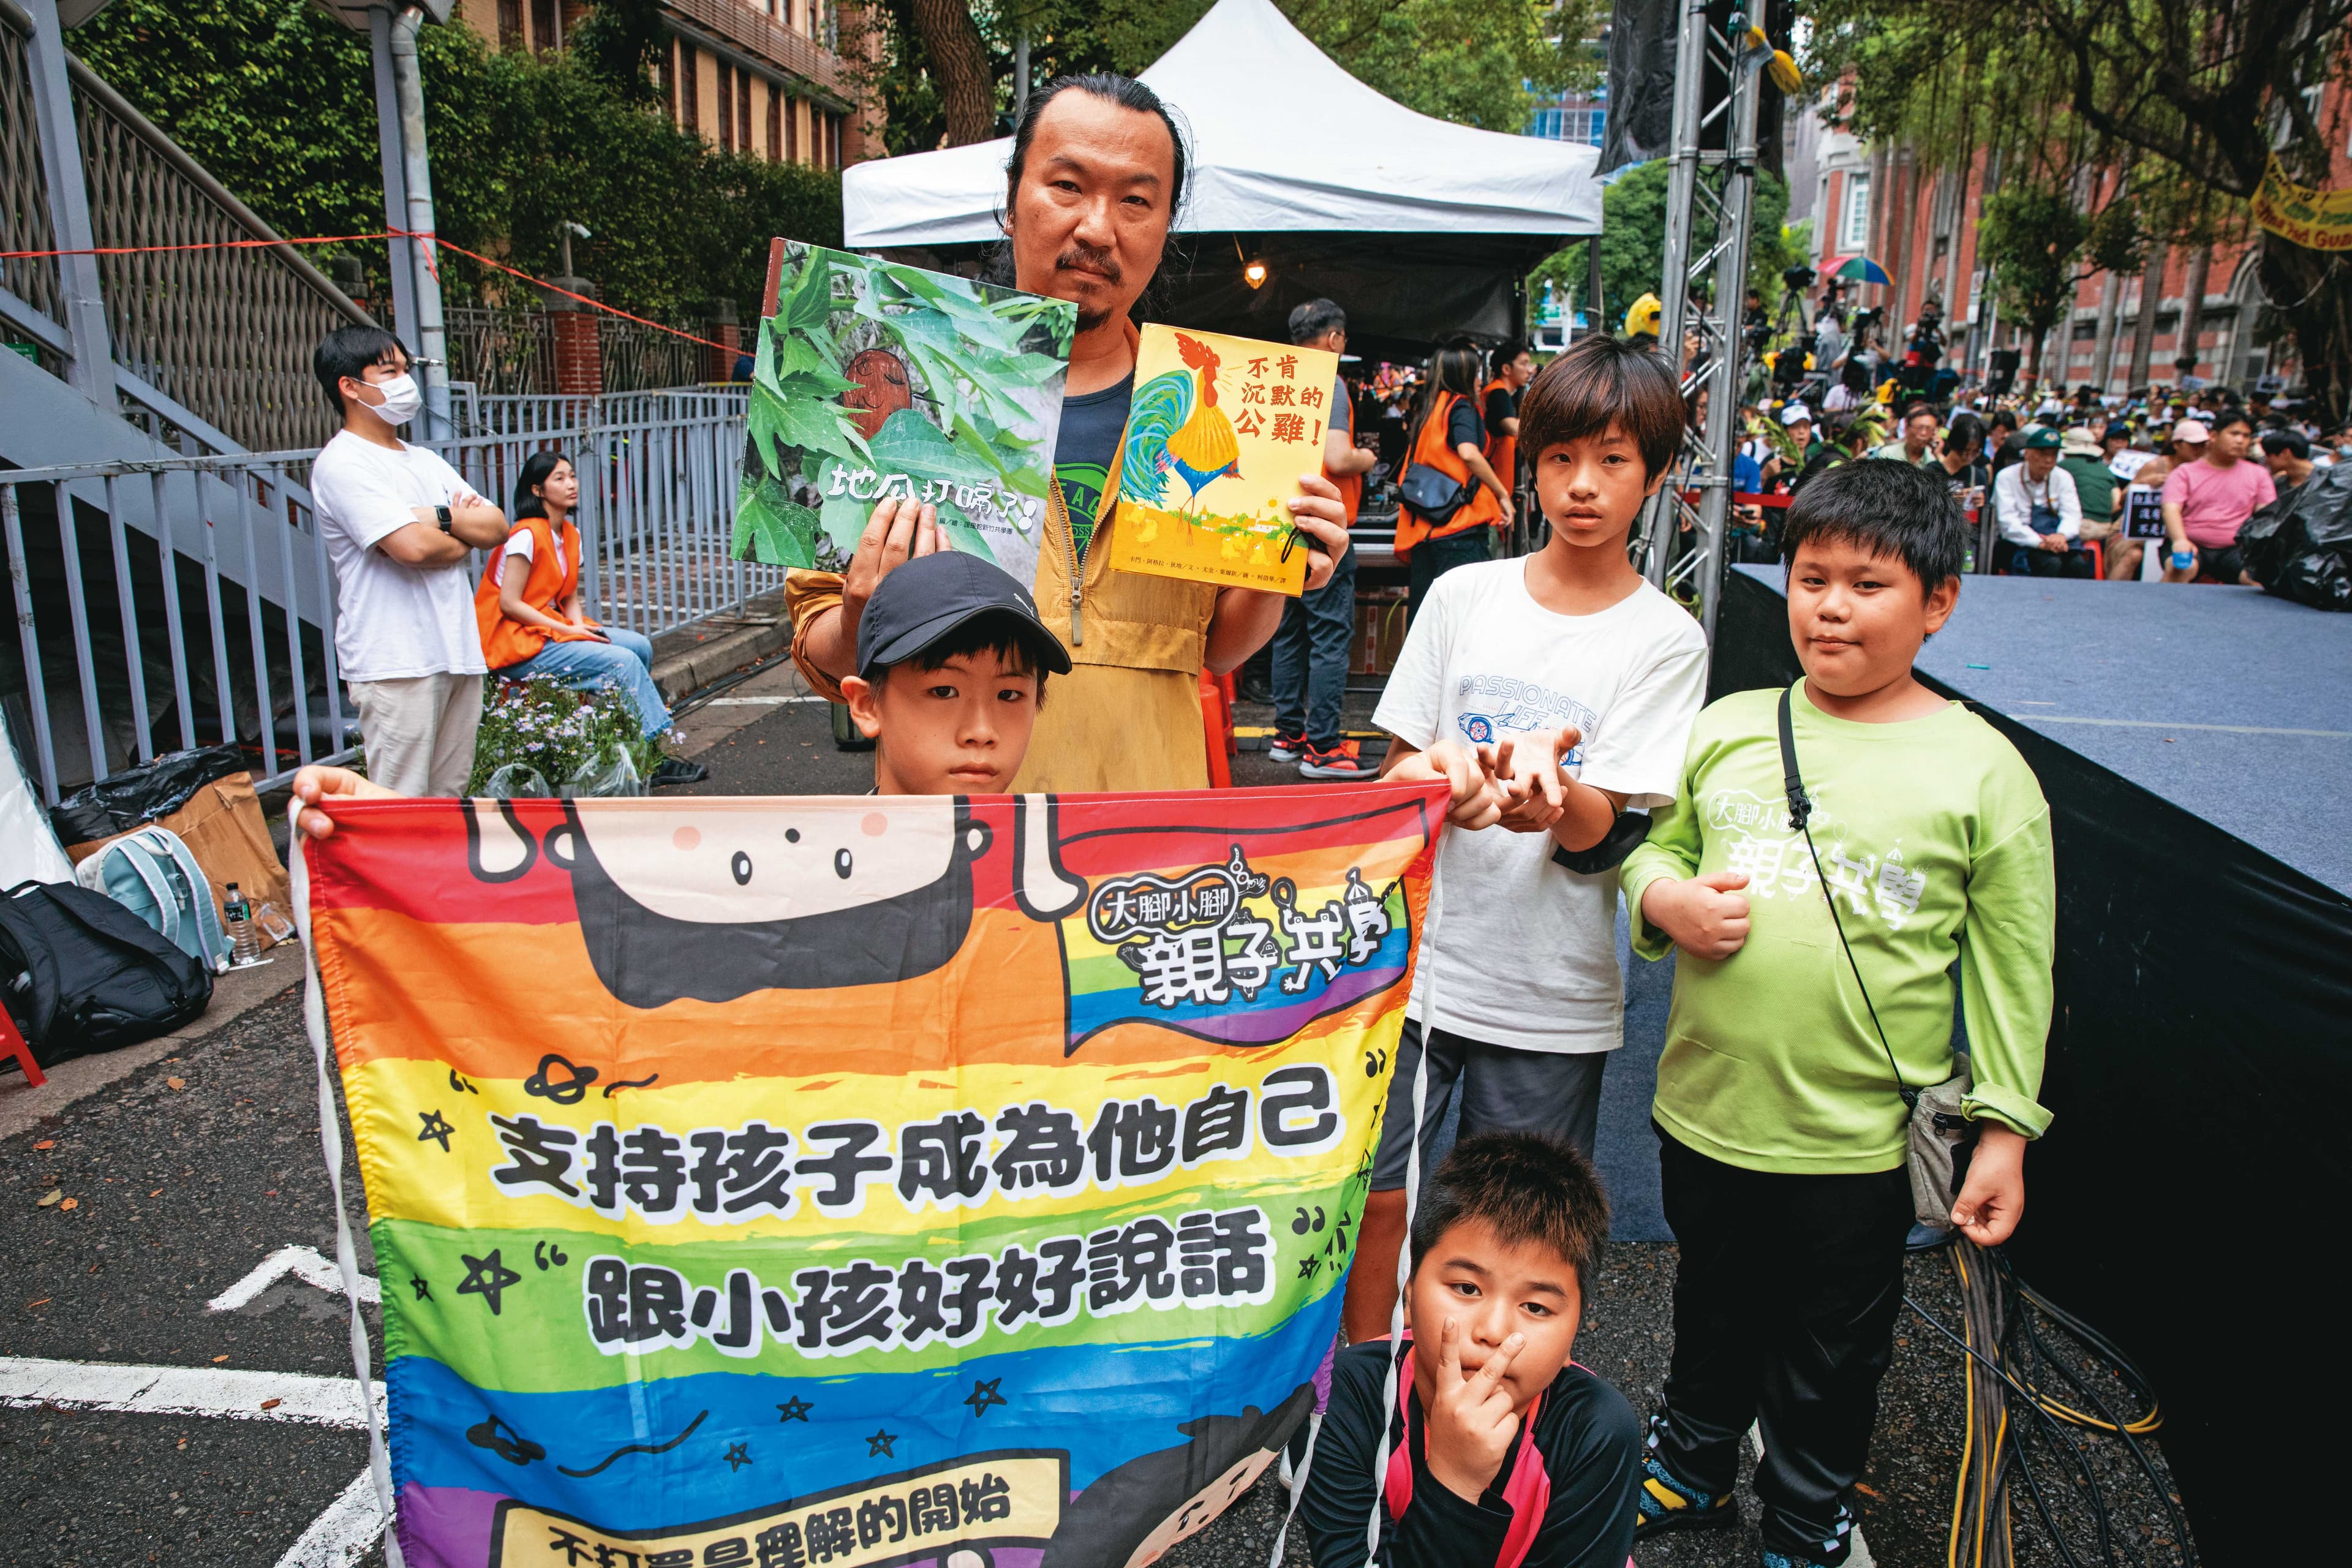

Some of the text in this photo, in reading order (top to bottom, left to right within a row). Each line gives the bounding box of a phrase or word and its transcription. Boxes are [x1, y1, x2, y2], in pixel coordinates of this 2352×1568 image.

[1247, 354, 1298, 380] 不肯
[1241, 382, 1324, 410] 沉默的
[1234, 408, 1322, 447] 公雞！
[827, 462, 1038, 531] 地瓜打嗝了！
[1459, 674, 1597, 733] PASSIONATE
[1497, 701, 1550, 730] LIFE
[1107, 887, 1229, 929] 大腳小腳
